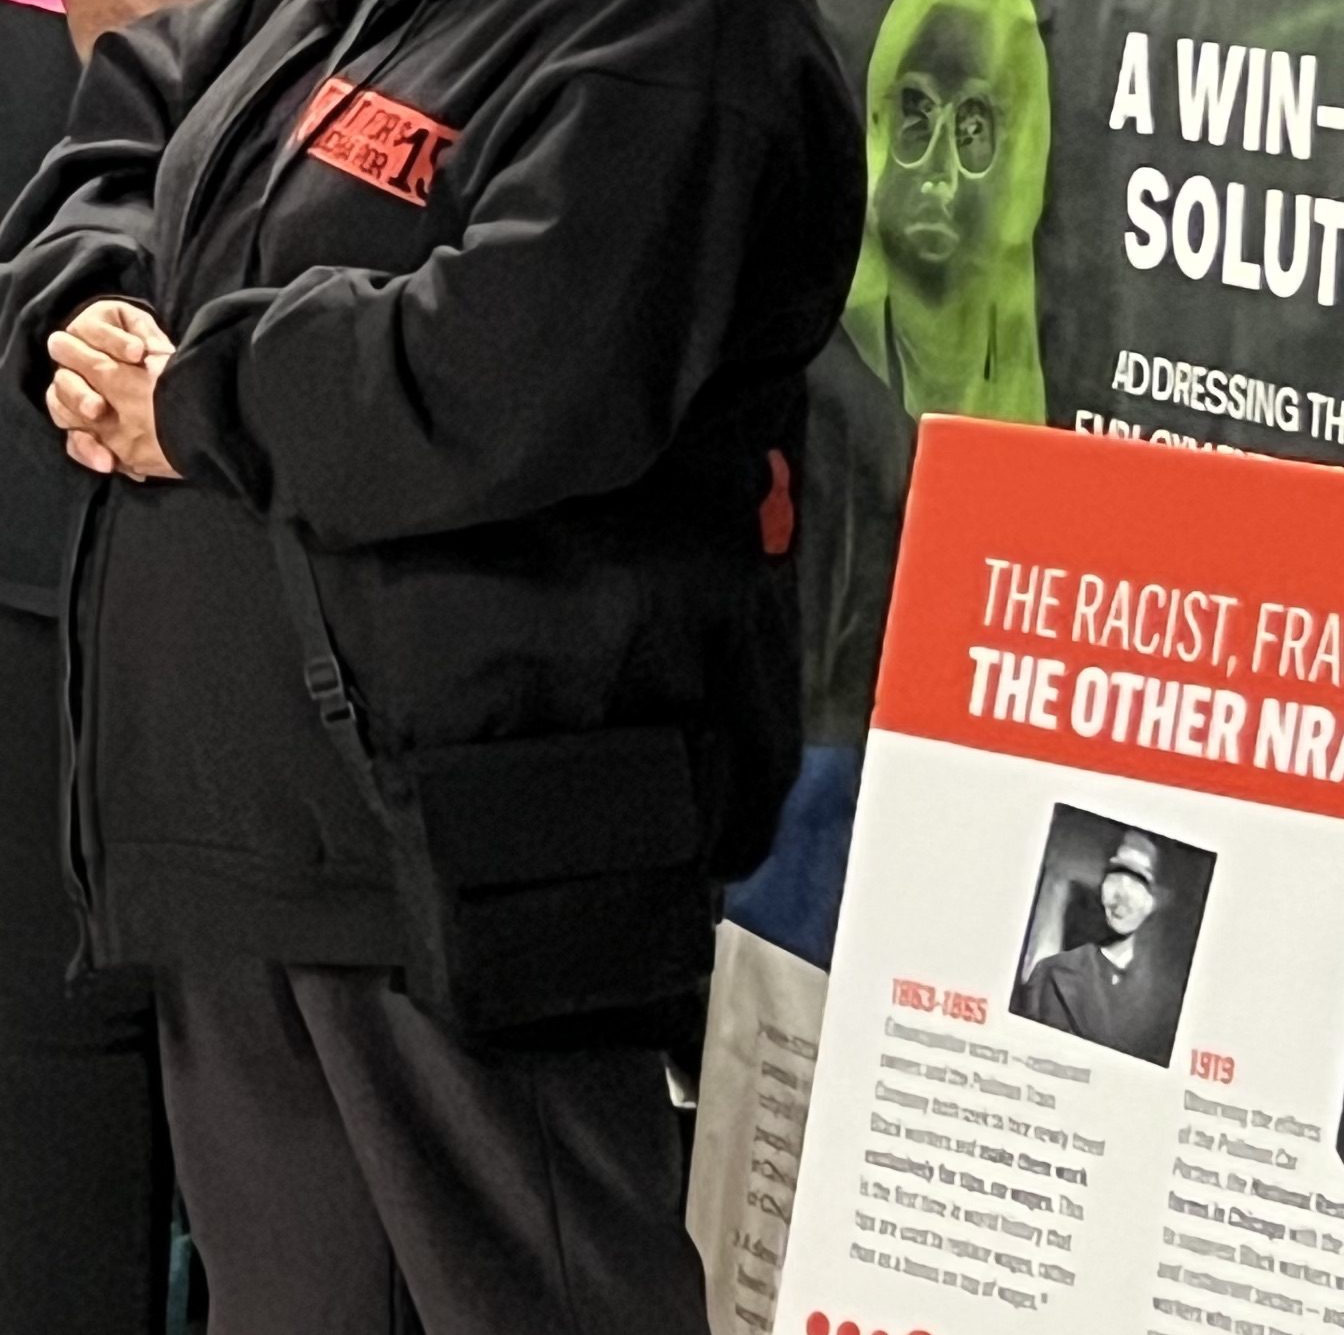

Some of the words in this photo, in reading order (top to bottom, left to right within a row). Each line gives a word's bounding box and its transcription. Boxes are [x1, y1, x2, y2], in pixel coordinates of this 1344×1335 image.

[1109, 31, 1154, 134] A
[1177, 38, 1344, 159] WIN-
[1124, 166, 1344, 306] SOLUT
[1112, 350, 1300, 431] ADDRESSING
[983, 557, 1068, 638] THE
[1072, 573, 1239, 678] RACIST,
[1251, 602, 1342, 687] FRA
[969, 646, 1067, 730] THE
[1071, 666, 1248, 764] OTHER
